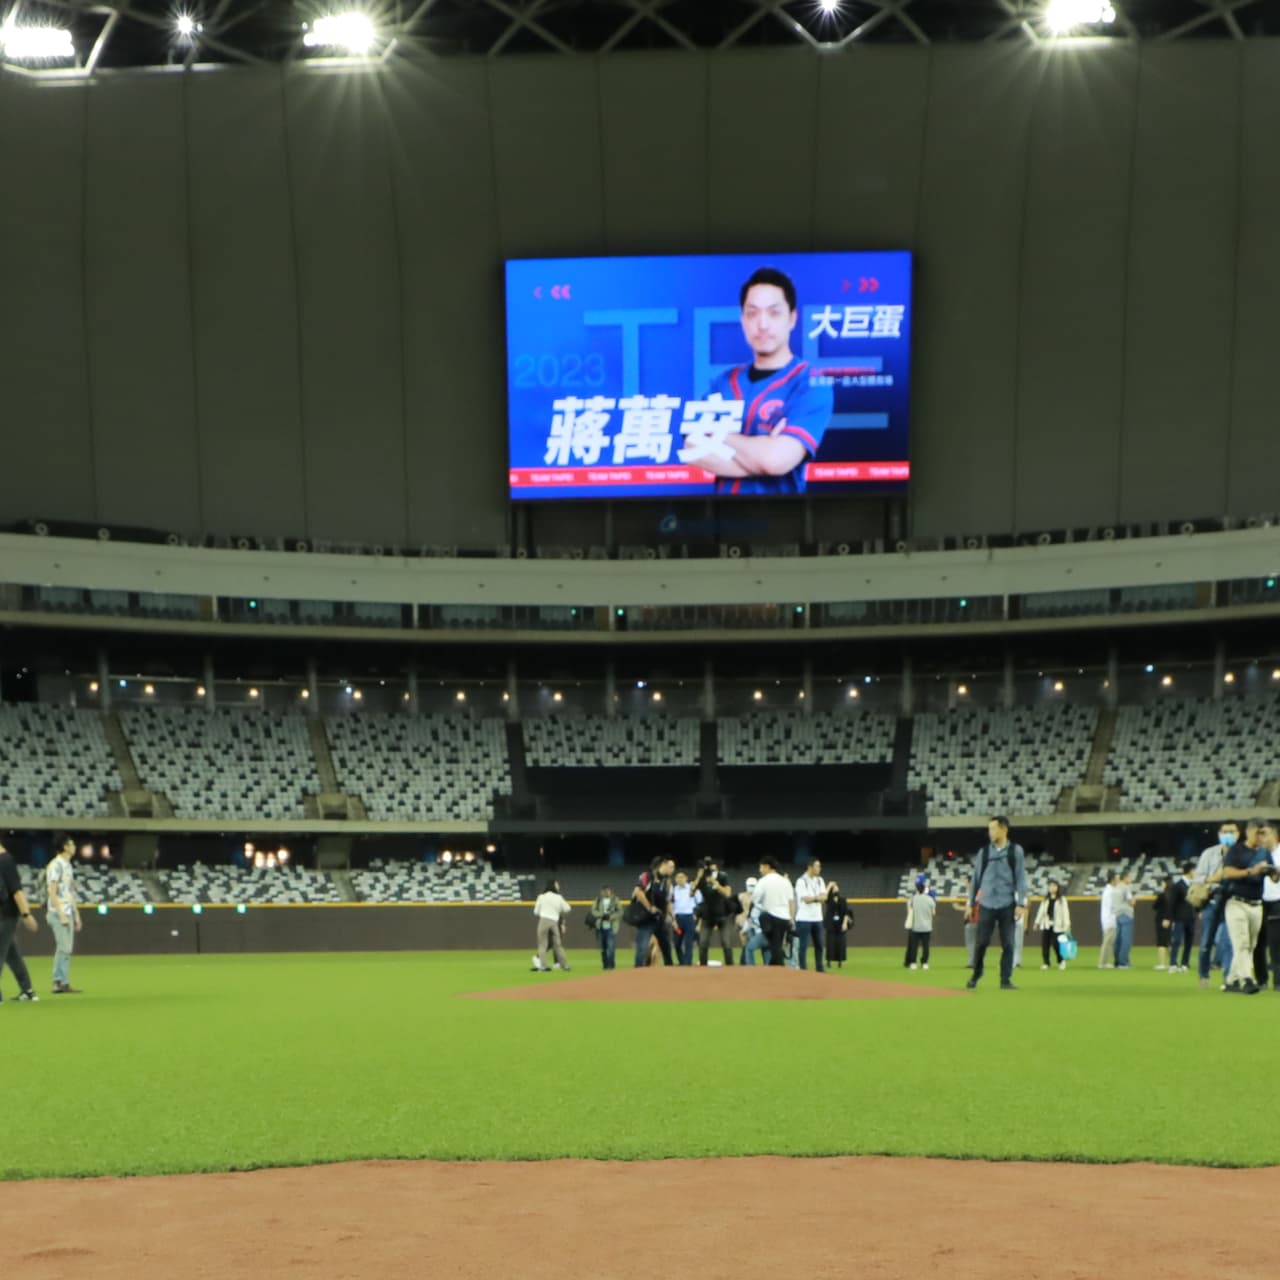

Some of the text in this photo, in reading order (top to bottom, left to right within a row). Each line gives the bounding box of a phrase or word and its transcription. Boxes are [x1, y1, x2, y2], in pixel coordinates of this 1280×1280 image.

[808, 304, 904, 338] 大巨蛋
[514, 353, 607, 389] 2023
[543, 393, 745, 466] 蔣萬安
